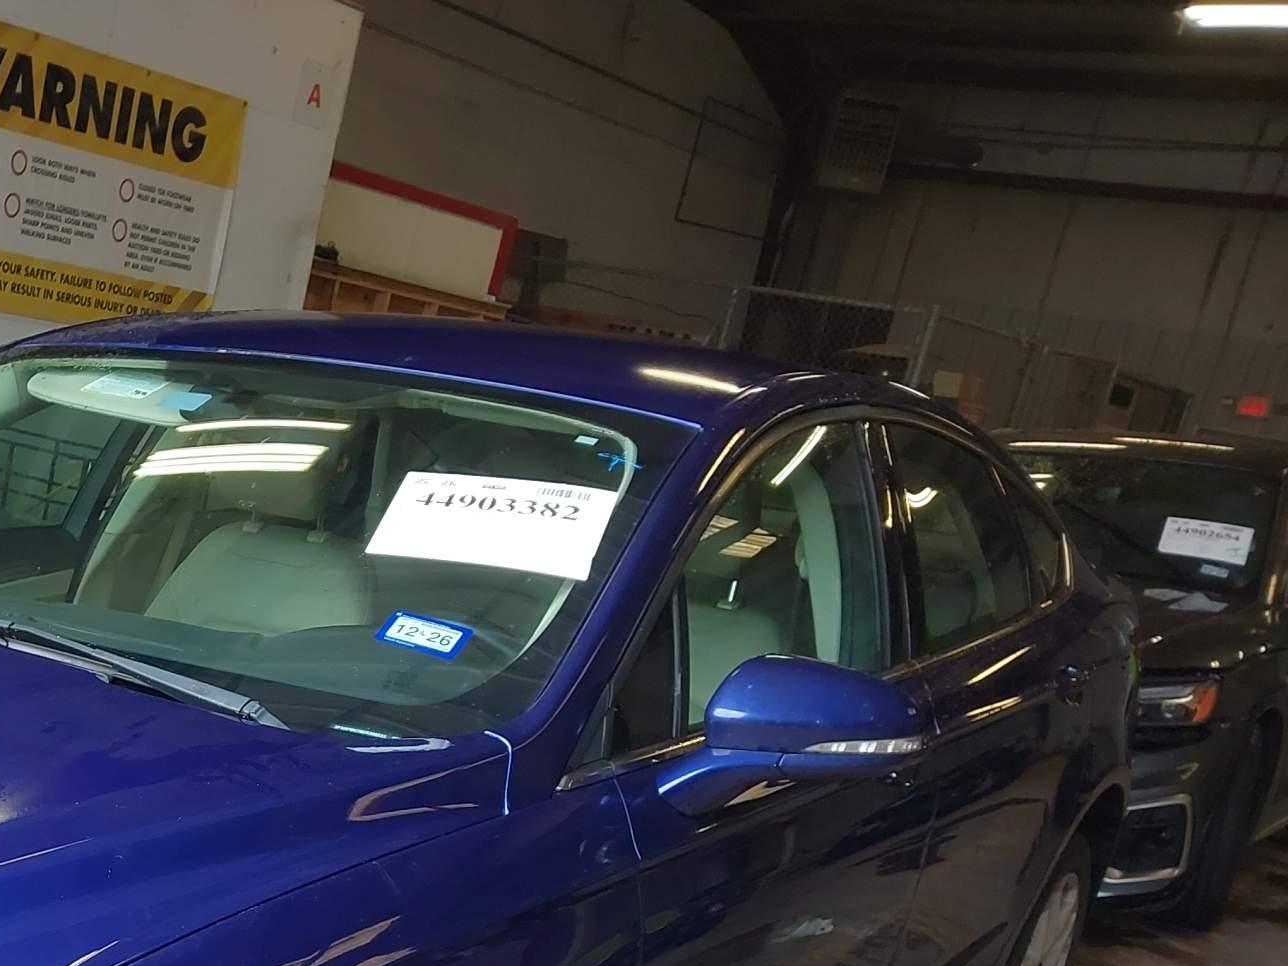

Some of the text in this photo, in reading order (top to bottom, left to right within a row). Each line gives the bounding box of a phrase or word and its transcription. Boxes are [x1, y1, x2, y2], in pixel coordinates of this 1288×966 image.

[306, 83, 321, 108] A
[11, 281, 41, 298] RESULT
[43, 288, 54, 300] IN
[56, 291, 92, 308] SERIOUS
[93, 298, 124, 313] INJURY
[126, 304, 138, 315] OR
[24, 265, 57, 282] SAFETY.
[59, 273, 94, 289] FAILURE
[95, 280, 106, 292] TO
[108, 283, 142, 299] FOLLOW
[143, 290, 173, 304] POSTED
[416, 492, 580, 521] 44903382
[1175, 526, 1241, 541] 44902654
[396, 624, 419, 637] 12
[426, 631, 453, 646] 26
